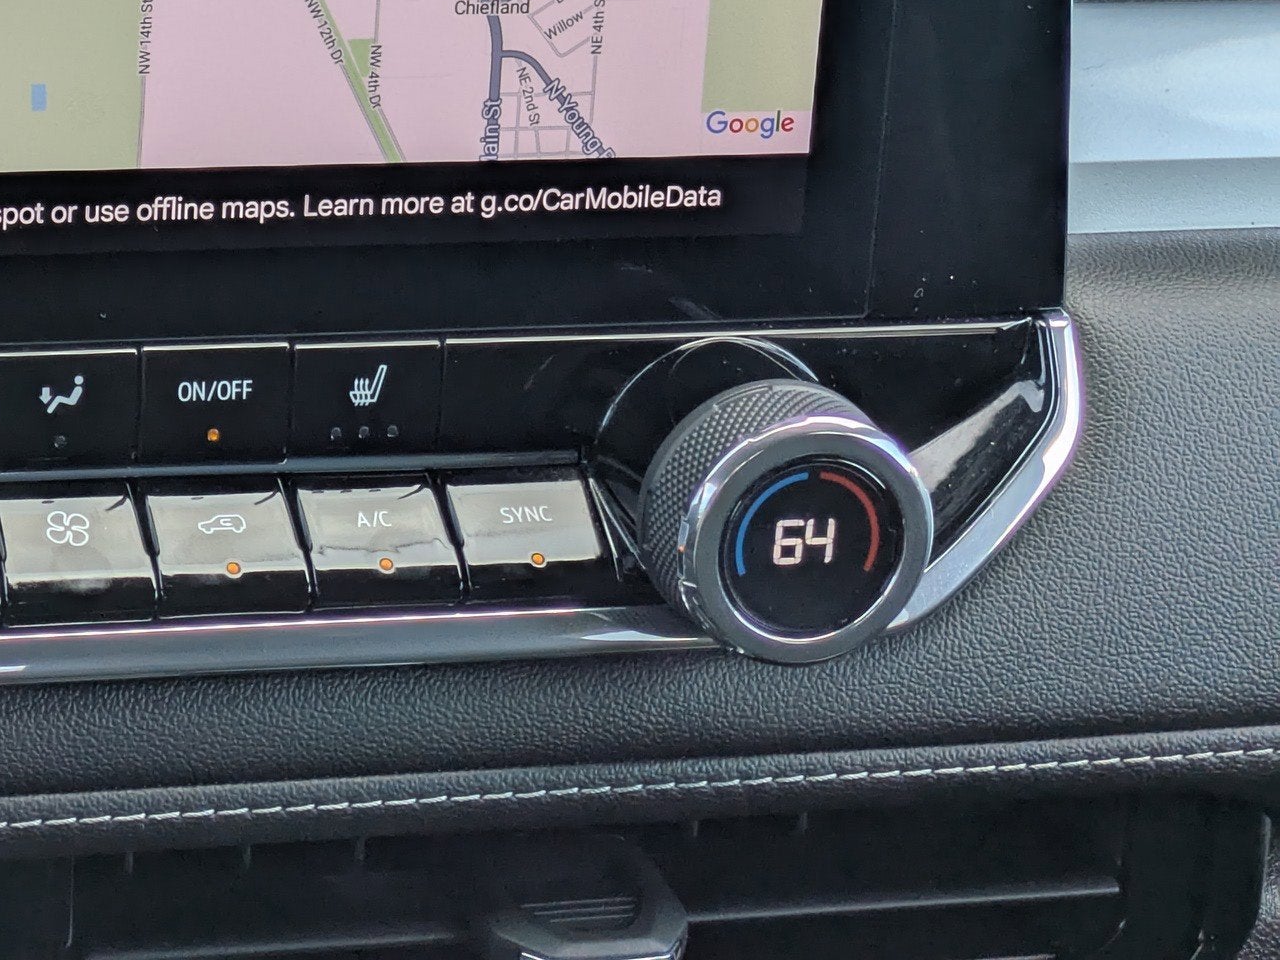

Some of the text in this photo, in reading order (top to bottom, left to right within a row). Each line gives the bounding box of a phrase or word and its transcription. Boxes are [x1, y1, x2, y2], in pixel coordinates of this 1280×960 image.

[455, 0, 530, 15] Chiefland
[592, 10, 605, 33] 4th
[140, 16, 152, 45] 14th
[544, 11, 584, 40] Willow
[318, 20, 337, 49] 12th
[330, 49, 344, 65] Dr
[591, 35, 603, 54] NE
[139, 51, 150, 74] NW
[368, 45, 382, 108] NW 4th Dr
[482, 98, 502, 120] St
[517, 67, 540, 126] NE 2nd St
[543, 78, 602, 154] N Young
[706, 110, 794, 139] Google
[51, 205, 75, 223] or
[84, 204, 129, 223] use
[136, 196, 215, 222] offline
[221, 200, 294, 224] maps.
[303, 194, 374, 218] Learn
[381, 196, 444, 216] more
[450, 192, 475, 213] at
[480, 185, 721, 218] g.co/CarMobileData
[178, 380, 252, 402] ON/OFF
[357, 510, 392, 528] A/C
[500, 505, 553, 524] SYNC
[772, 519, 837, 566] 64
